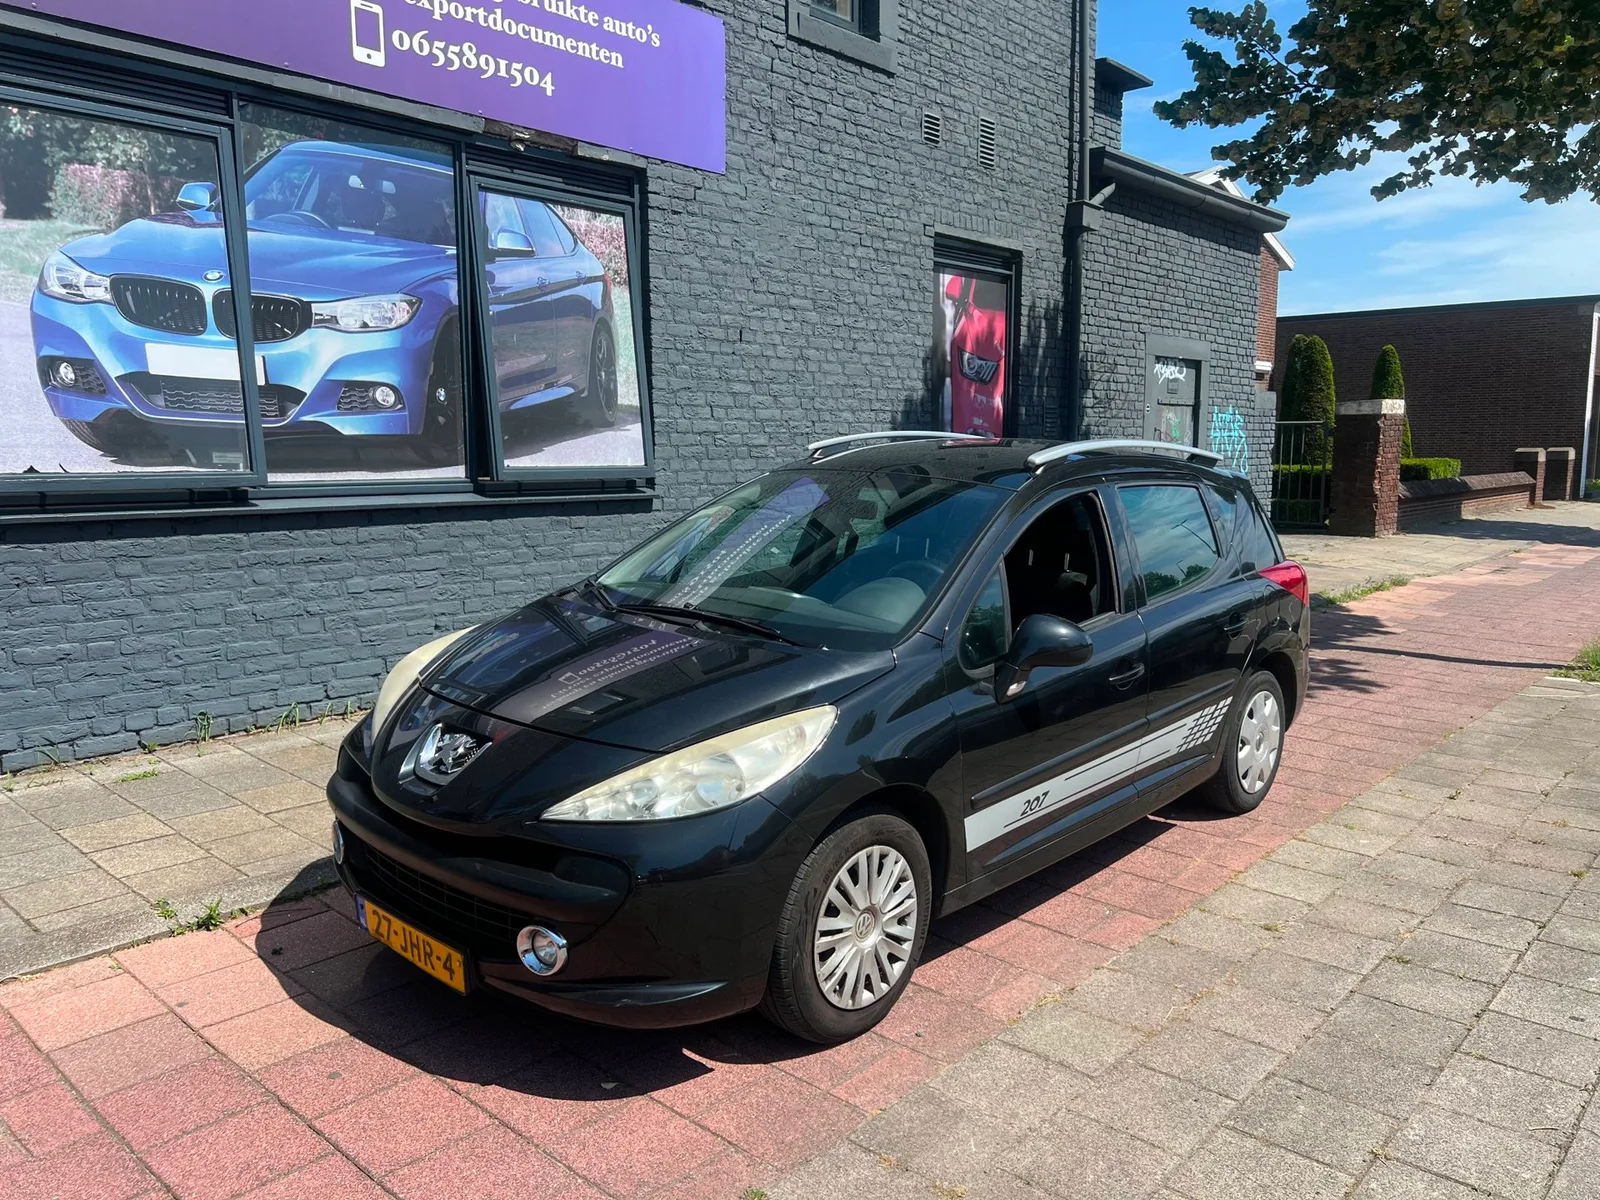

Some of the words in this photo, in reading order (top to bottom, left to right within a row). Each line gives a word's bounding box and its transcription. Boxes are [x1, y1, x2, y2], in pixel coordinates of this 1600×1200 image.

[392, 29, 555, 97] 0655891504
[405, 0, 624, 68] xportdocumenten
[603, 16, 661, 48] auto's
[1020, 789, 1050, 817] 207
[372, 908, 455, 981] 27-JHR-4
